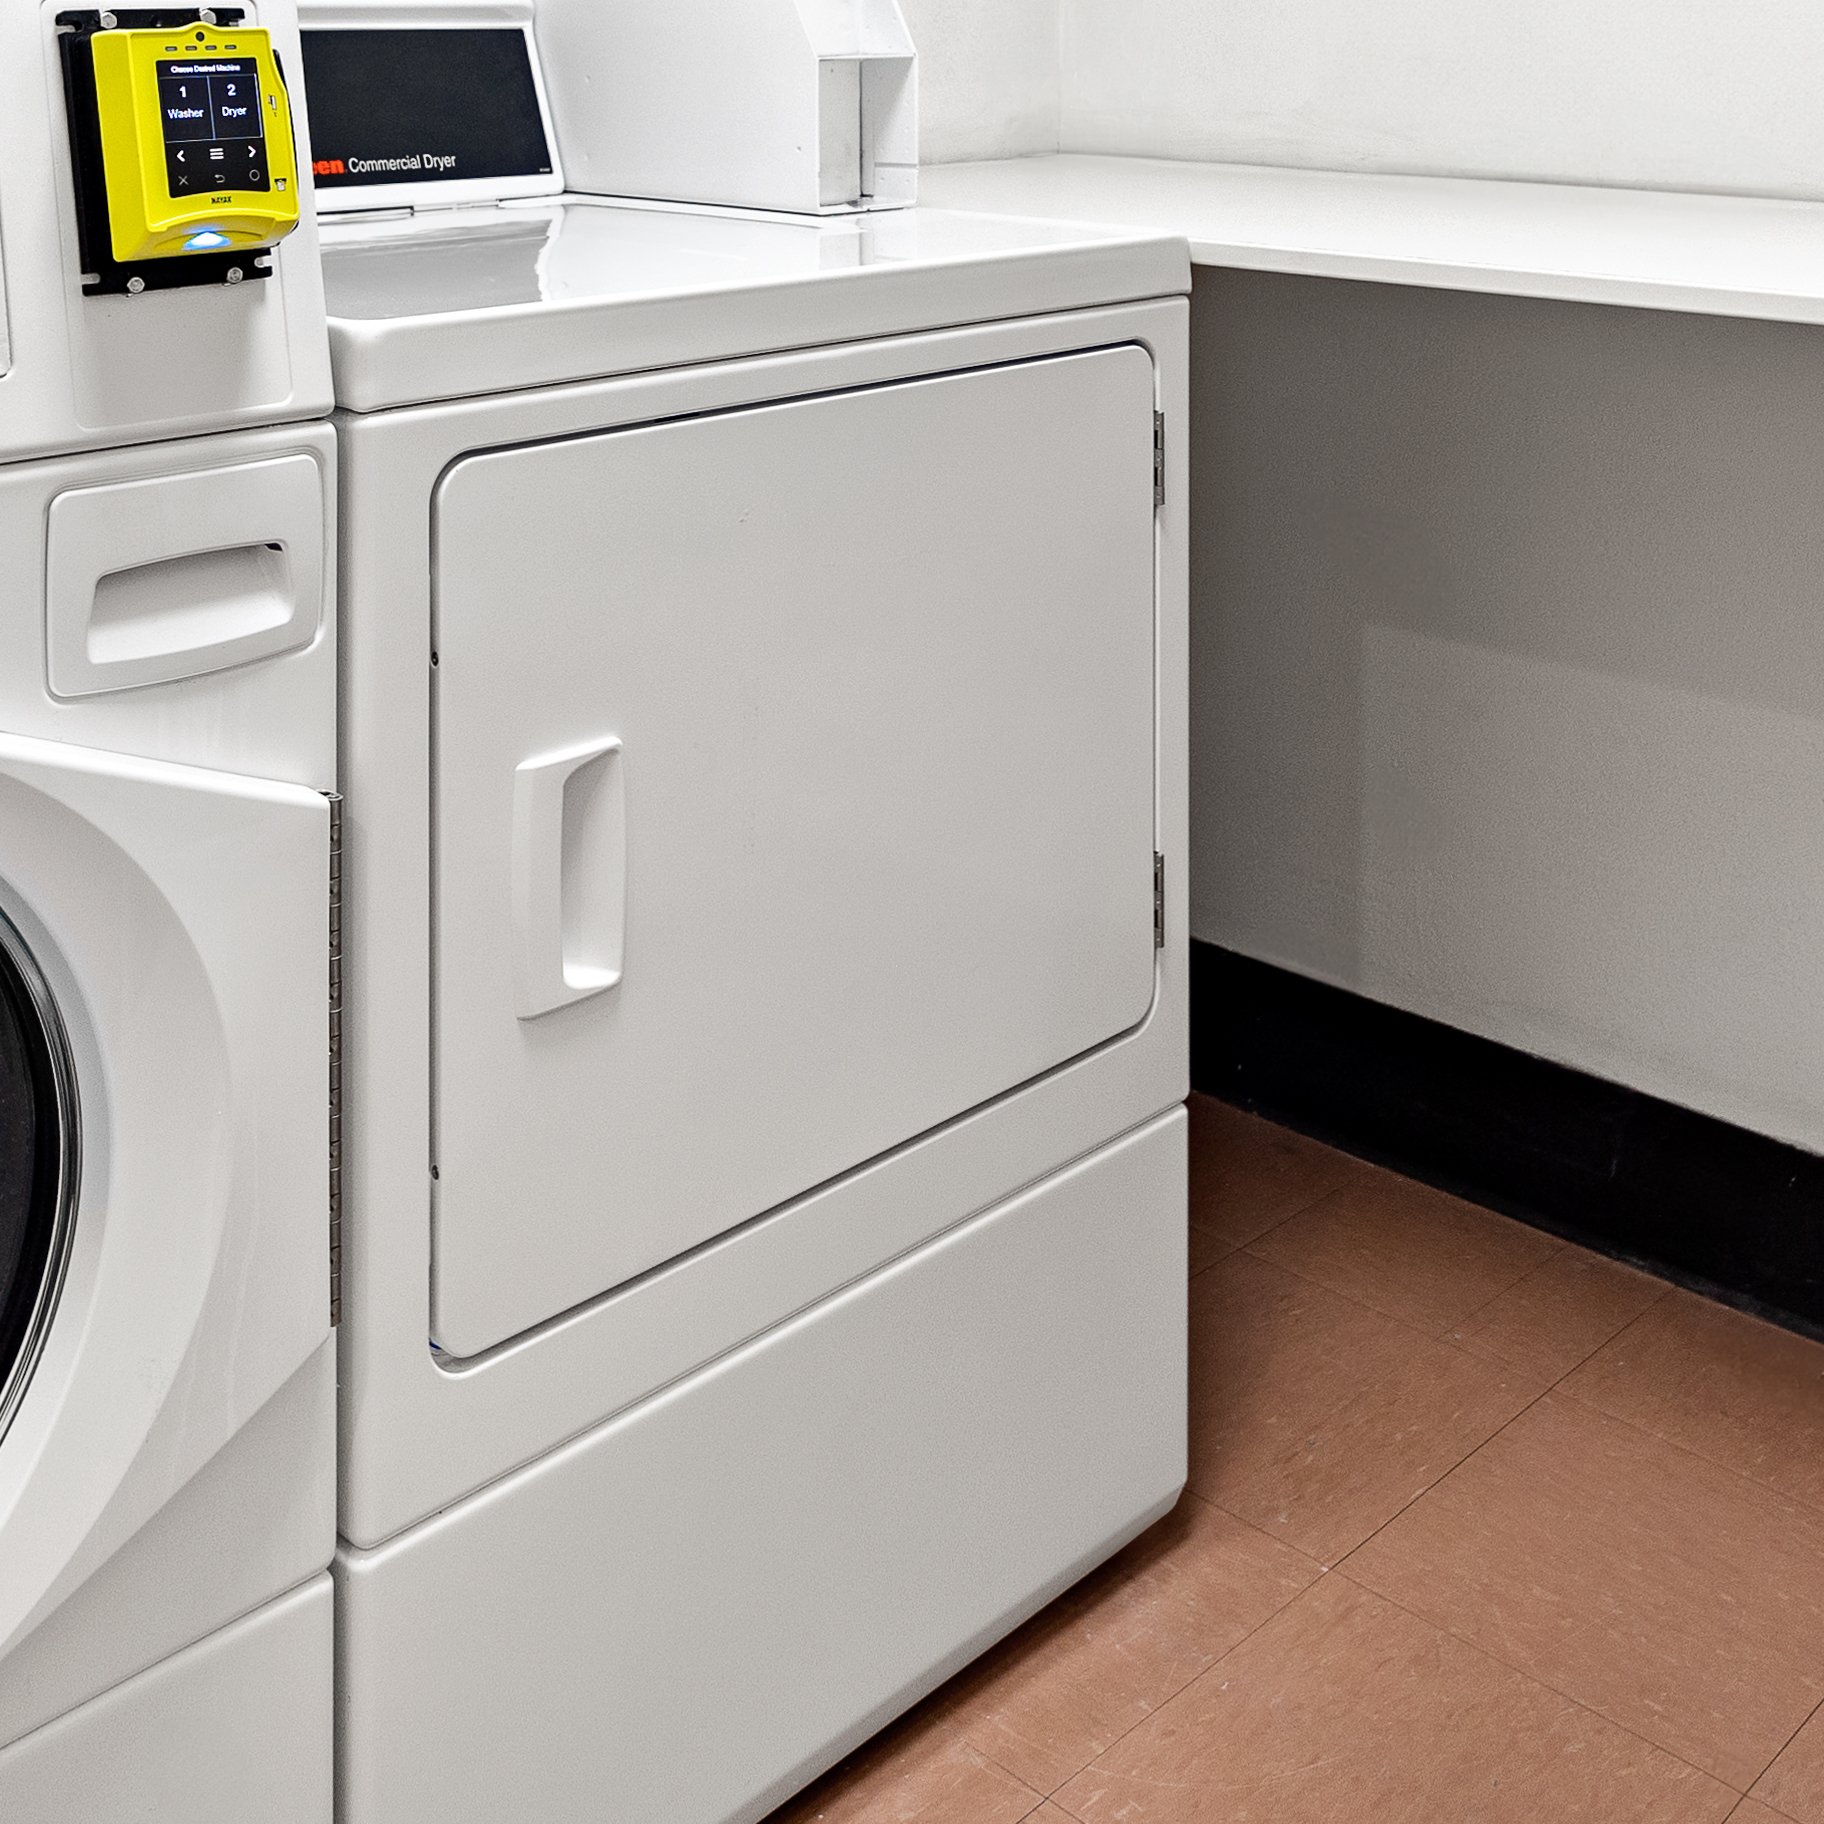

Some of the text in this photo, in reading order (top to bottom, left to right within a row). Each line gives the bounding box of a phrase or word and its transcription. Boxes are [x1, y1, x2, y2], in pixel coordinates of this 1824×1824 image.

[179, 86, 187, 98] 1
[226, 83, 237, 96] 2
[168, 107, 204, 119] Washer
[222, 106, 247, 118] Dryer
[348, 155, 421, 173] Commercial
[423, 153, 456, 171] Dryer
